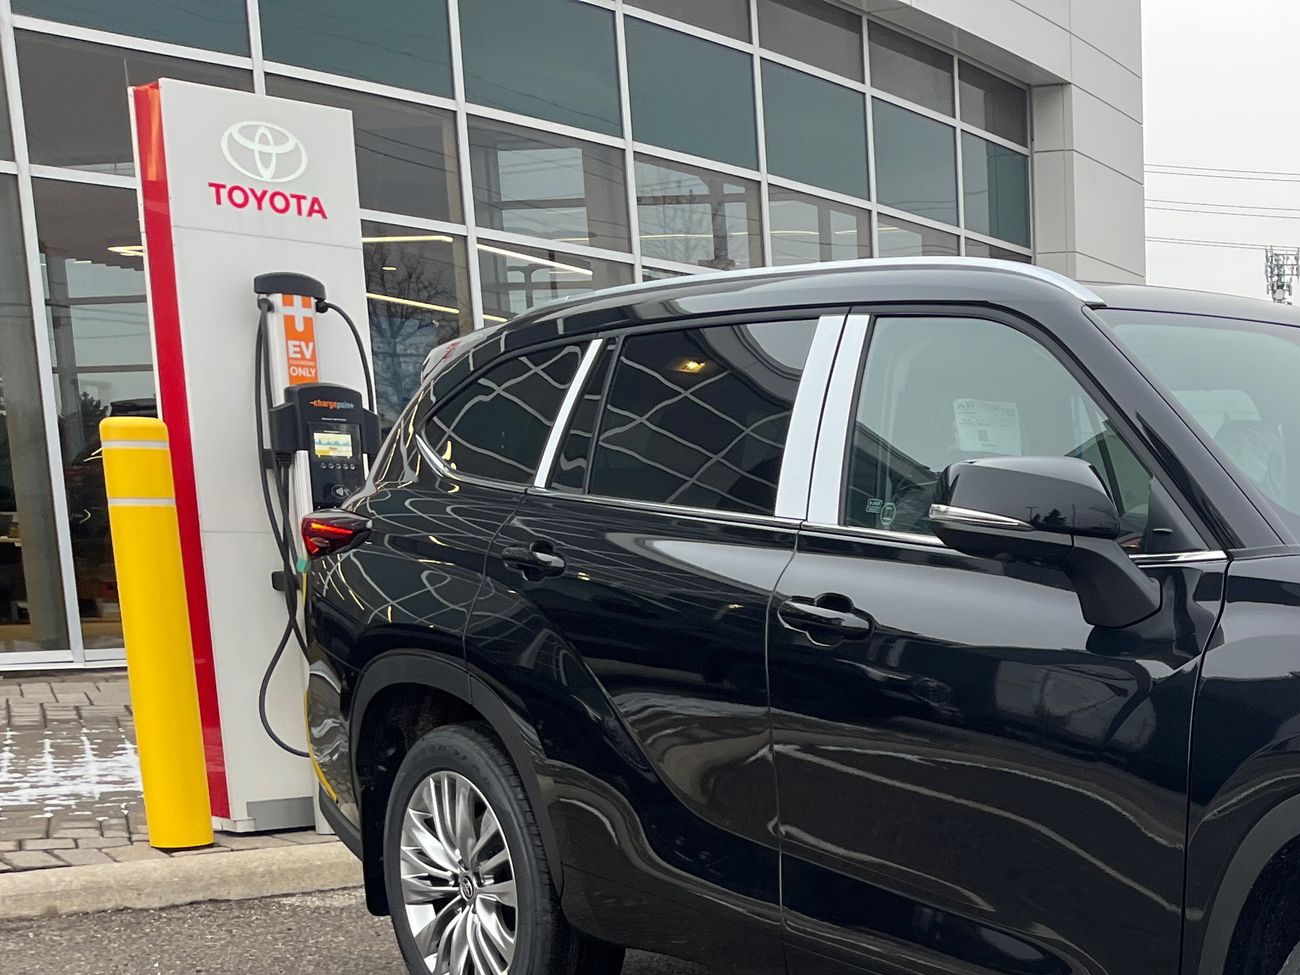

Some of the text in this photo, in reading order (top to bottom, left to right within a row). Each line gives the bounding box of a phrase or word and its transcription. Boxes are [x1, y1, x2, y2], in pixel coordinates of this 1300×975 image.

[208, 182, 328, 220] TOYOTA
[288, 340, 314, 359] EV
[290, 366, 316, 377] ONLY
